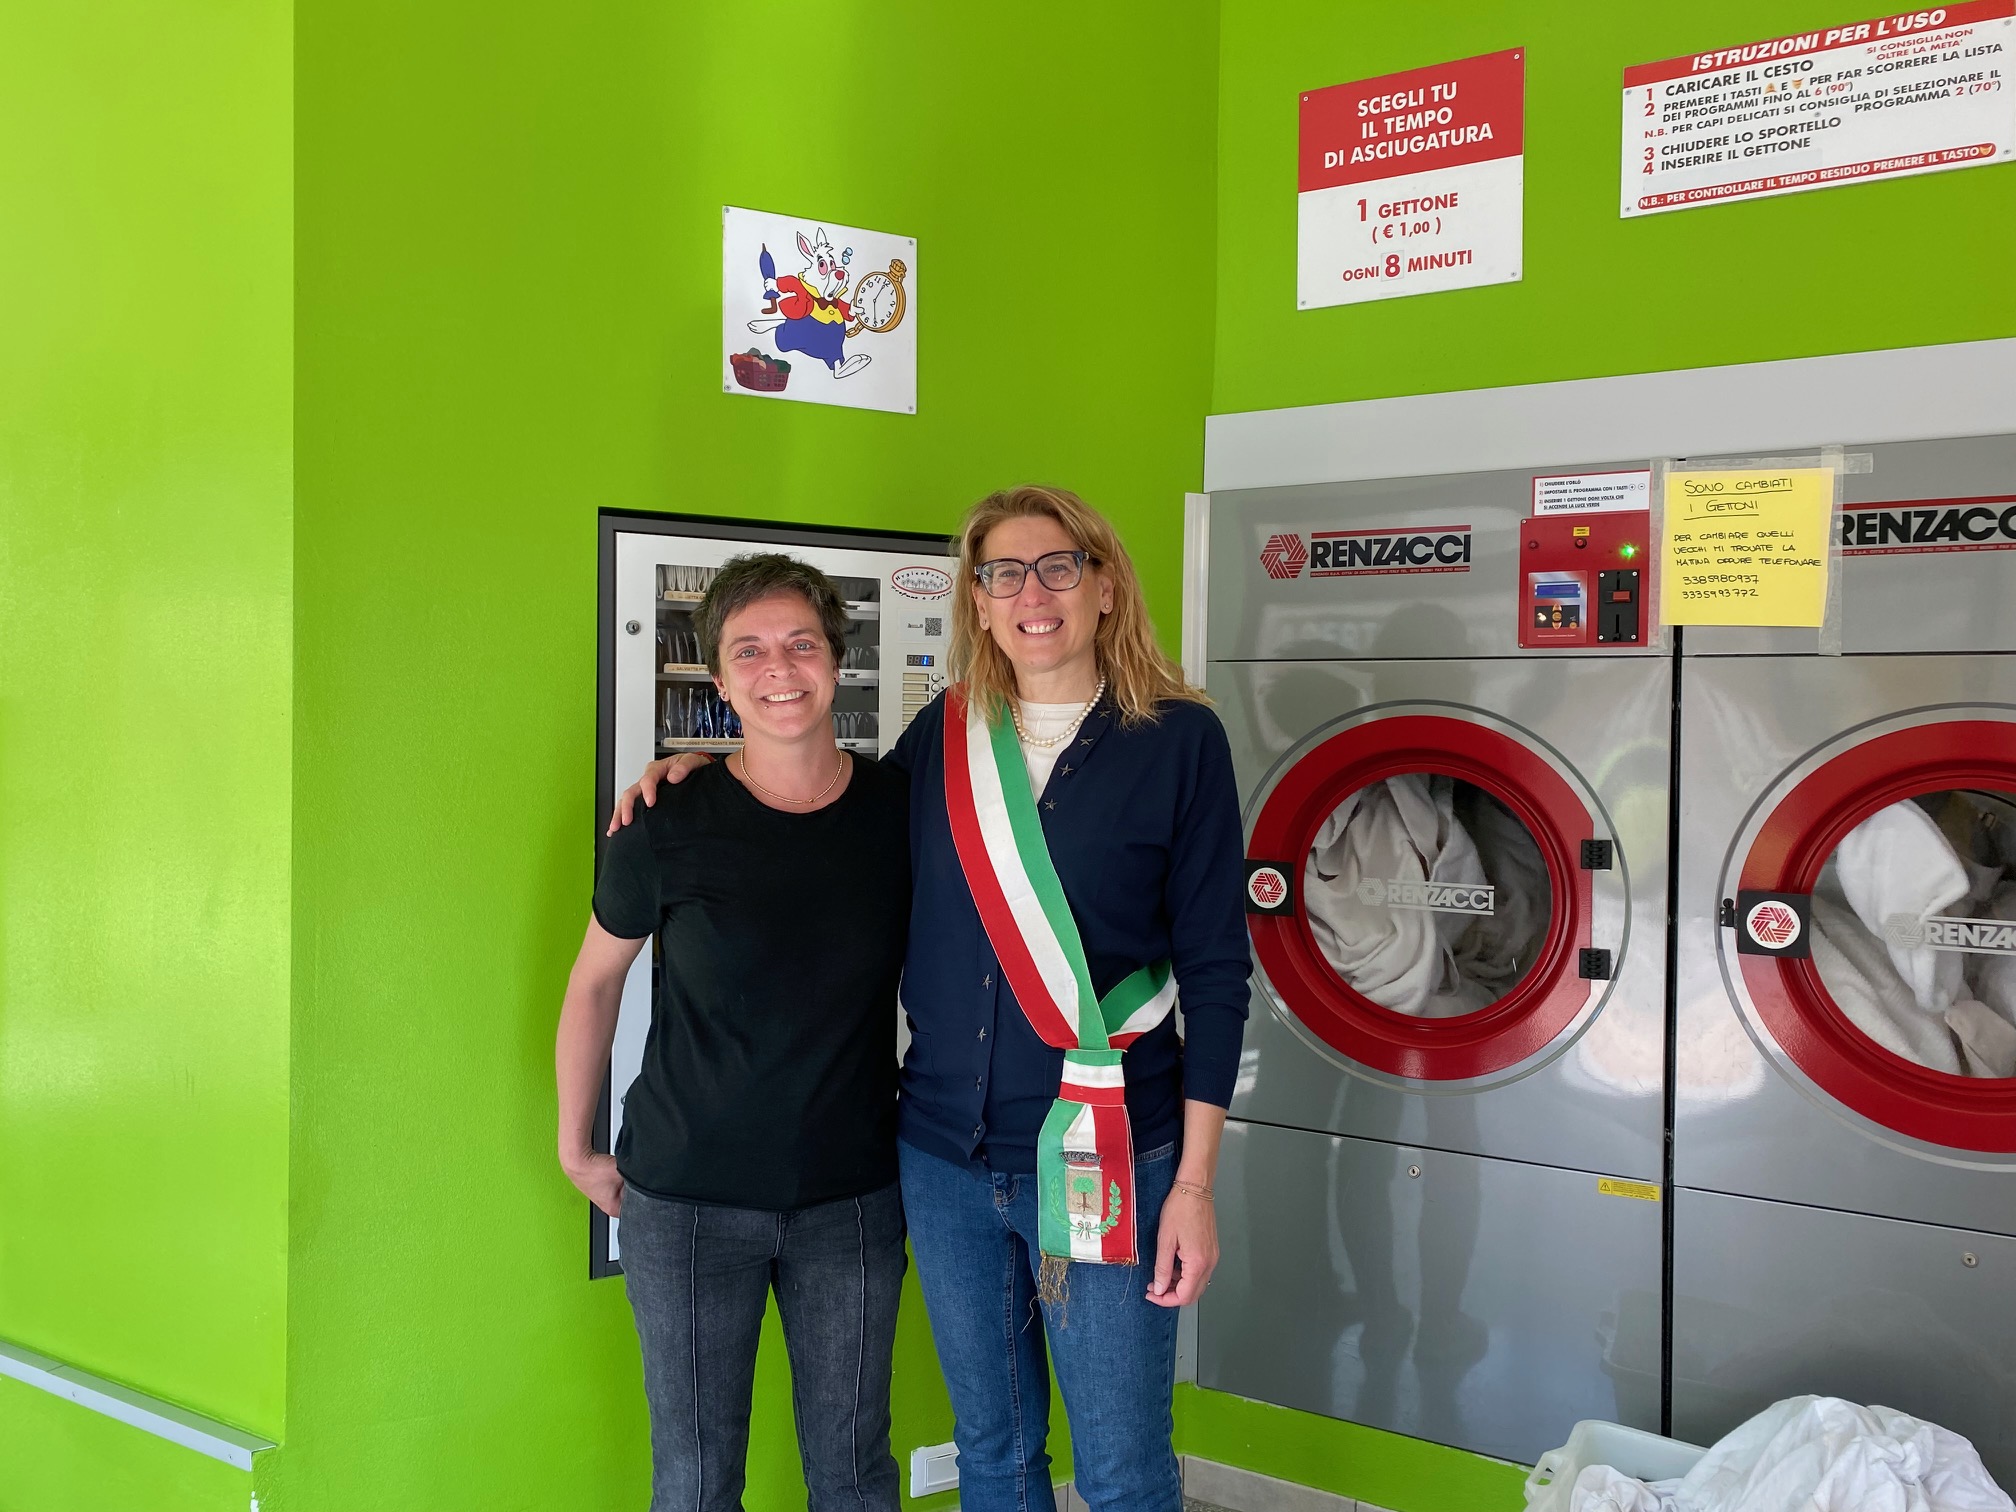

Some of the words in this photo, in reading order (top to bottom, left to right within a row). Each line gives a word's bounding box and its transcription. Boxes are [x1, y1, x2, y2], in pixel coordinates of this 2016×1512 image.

[1692, 33, 1819, 71] ISTRUZIONI
[1824, 24, 1870, 46] PER
[1876, 9, 1946, 36] L'USO
[1867, 46, 1876, 54] SI
[1880, 34, 1943, 53] CONSIGLIA
[1945, 28, 1974, 40] NON
[1876, 50, 1908, 60] OLTRE
[1913, 46, 1926, 54] LA
[1930, 39, 1963, 52] META'
[1644, 103, 1655, 117] 2
[1664, 95, 1719, 112] PREMERE
[1722, 92, 1727, 102] I
[1730, 86, 1762, 100] TASTI
[1781, 82, 1788, 91] E
[1810, 74, 1832, 86] PER
[1837, 68, 1862, 80] FAR
[1866, 54, 1938, 76] SCORRERE
[1942, 51, 1960, 62] LA
[1964, 44, 2002, 58] LISTA
[1646, 88, 1653, 101] 1
[1666, 73, 1740, 96] CARICARE
[1746, 69, 1758, 82] IL
[1764, 60, 1814, 78] CESTO
[1357, 88, 1424, 117] SCEGLI
[1431, 82, 1458, 101] TU
[1644, 128, 1668, 138] N.B.
[1672, 123, 1693, 134] PER
[1696, 118, 1723, 130] CAPI
[1728, 109, 1780, 124] DELICATI
[1784, 105, 1795, 114] SI
[1800, 93, 1870, 112] CONSIGLIA
[1875, 89, 1889, 98] DI
[1893, 72, 1984, 95] SELEZIONARE
[1990, 69, 2002, 79] IL
[1662, 112, 1680, 122] DEI
[1685, 98, 1758, 119] PROGRAMMI
[1763, 92, 1792, 106] FINO
[1796, 89, 1812, 99] AL
[1814, 88, 1822, 96] 6
[1854, 89, 1950, 113] PROGRAMMA
[1955, 86, 1964, 96] 2
[1362, 121, 1378, 140] IL
[1384, 106, 1453, 134] TEMPO
[1644, 147, 1655, 161] 3
[1662, 136, 1730, 156] CHIUDERE
[1734, 132, 1754, 144] LO
[1758, 116, 1842, 140] SPORTELLO
[1324, 151, 1344, 168] DI
[1350, 122, 1494, 164] ASCIUGATURA
[1642, 162, 1654, 175] 4
[1661, 152, 1723, 171] INSERIRE
[1728, 150, 1739, 160] IL
[1744, 137, 1811, 157] GETTONE
[1666, 193, 1686, 203] PER
[1688, 180, 1764, 200] CONTROLLARE
[1767, 178, 1776, 188] IL
[1779, 172, 1817, 186] TEMPO
[1820, 164, 1870, 180] RESIDUO
[1874, 156, 1924, 172] PREMERE
[1928, 154, 1939, 164] IL
[1942, 146, 1980, 161] TASTO
[1356, 199, 1367, 222] 1
[1378, 192, 1458, 219] GETTONE
[1342, 266, 1380, 282] OGNI
[1384, 254, 1400, 278] 8
[1408, 250, 1472, 273] MINUTI
[1685, 480, 1724, 494] SONO
[1736, 478, 1792, 490] CAMBIATI
[1310, 534, 1472, 568] RENZACCI
[1700, 532, 1748, 540] CAMBIARE
[1758, 558, 1822, 566] TELEFONARE
[1388, 884, 1494, 910] RENZACCI
[1924, 922, 2016, 949] RENZA
